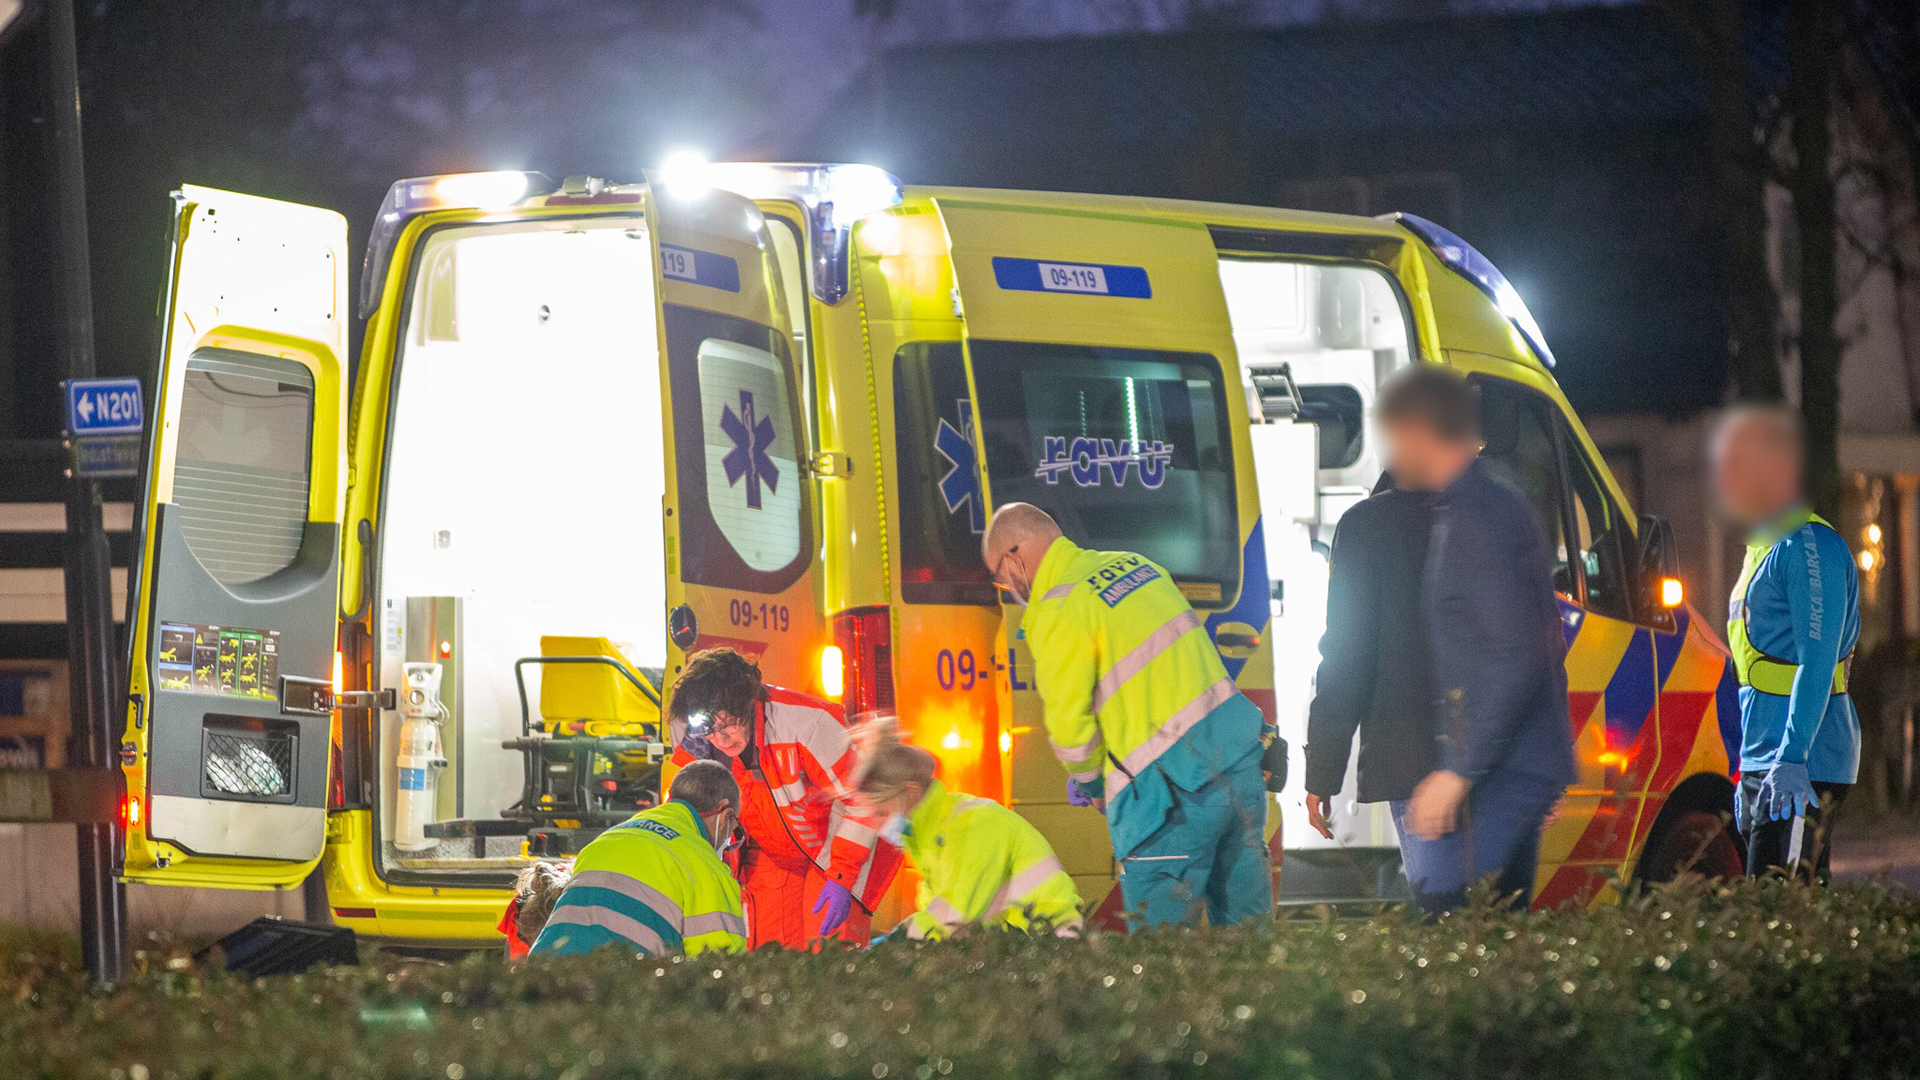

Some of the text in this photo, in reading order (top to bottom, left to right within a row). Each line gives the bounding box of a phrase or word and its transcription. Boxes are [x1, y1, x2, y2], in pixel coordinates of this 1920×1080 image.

[661, 251, 685, 273] 119
[1051, 267, 1096, 289] 09-119
[97, 392, 139, 420] N201
[1045, 436, 1166, 489] ravu
[729, 599, 790, 632] 09-119
[937, 648, 996, 691] 09-
[636, 820, 677, 839] ANCE
